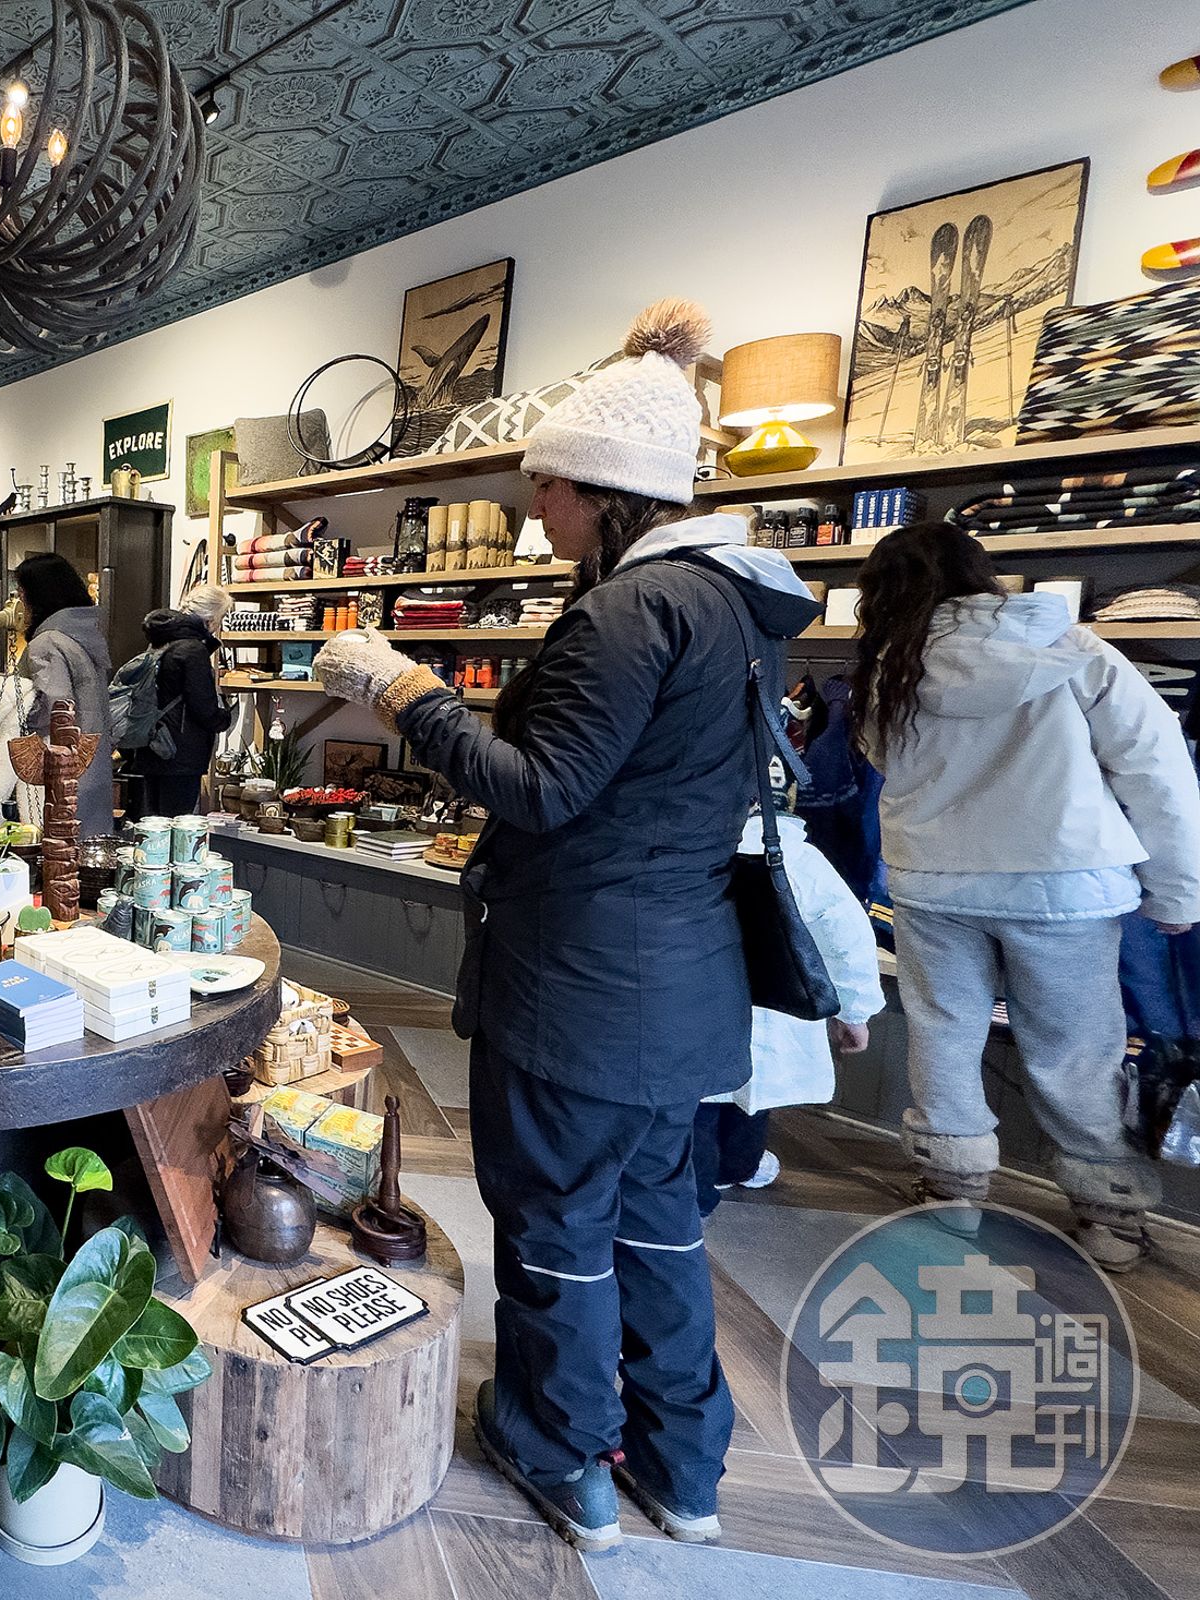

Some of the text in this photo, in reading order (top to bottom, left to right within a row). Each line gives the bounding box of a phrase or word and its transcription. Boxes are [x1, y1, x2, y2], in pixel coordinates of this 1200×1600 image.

[108, 432, 164, 460] EXPLORE
[301, 1274, 388, 1319] NO SHOES
[332, 1293, 407, 1334] PLEASE
[256, 1308, 293, 1331] NO
